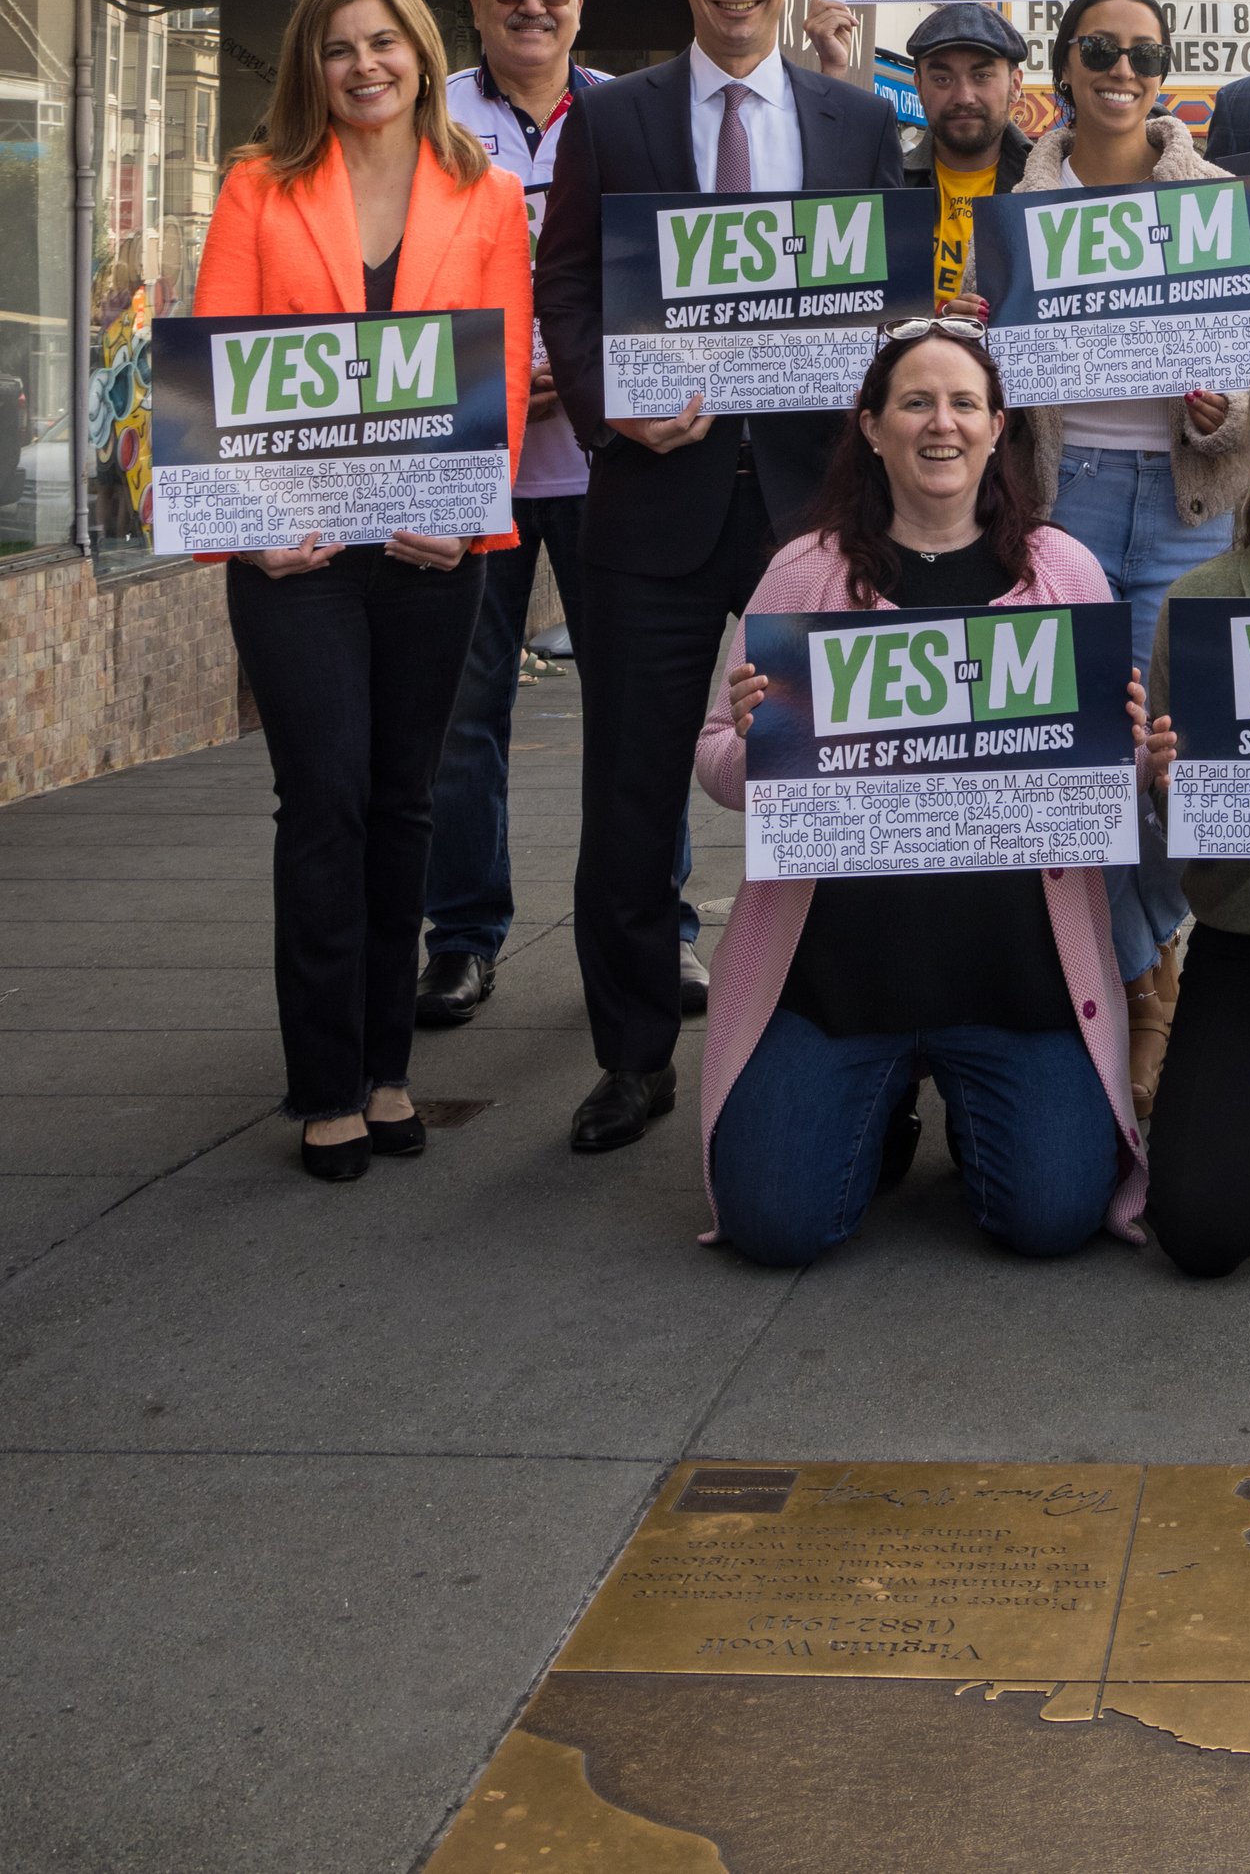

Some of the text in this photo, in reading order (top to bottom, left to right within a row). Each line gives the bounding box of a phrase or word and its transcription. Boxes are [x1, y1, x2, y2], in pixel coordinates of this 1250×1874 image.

[669, 210, 776, 287] YES
[784, 237, 803, 252] ON
[811, 201, 871, 277] M
[1038, 201, 1143, 278] YES
[1151, 226, 1168, 241] ON
[1178, 189, 1233, 264] M
[664, 289, 884, 329] SAVE SF SMALL BUSINESS
[1037, 294, 1081, 319] SAVE
[1084, 291, 1105, 313] SF
[1108, 284, 1164, 310] SMALL
[225, 332, 339, 415] YES
[348, 360, 367, 376] ON
[375, 321, 439, 401] M
[219, 413, 453, 458] SAVE SF SMALL BUSINESS
[159, 466, 504, 499] Top Funders: 1. Google ($500,000), 2. Airbnb ($250,000),
[824, 619, 1057, 722] YES ON M
[817, 723, 1073, 772] SAVE SF SMALL BUSINESS
[1174, 764, 1193, 778] Ad
[1198, 764, 1228, 778] Paid
[1233, 764, 1250, 778] for
[777, 845, 1108, 875] Financial disclosures are available at sfethics.org.
[866, 1526, 911, 1540] her
[920, 1526, 1011, 1542] during
[687, 1540, 1067, 1558] roles imposed upon women
[650, 1554, 767, 1569] religious
[838, 1559, 924, 1572] sexual
[1046, 1563, 1089, 1575] the
[618, 1571, 1107, 1592] and feminist whose work explored
[632, 1588, 1078, 1611] Pioneer of modernist literature
[748, 1614, 955, 1635] (1882-1941)
[696, 1637, 983, 1661] Virginia Woolf
